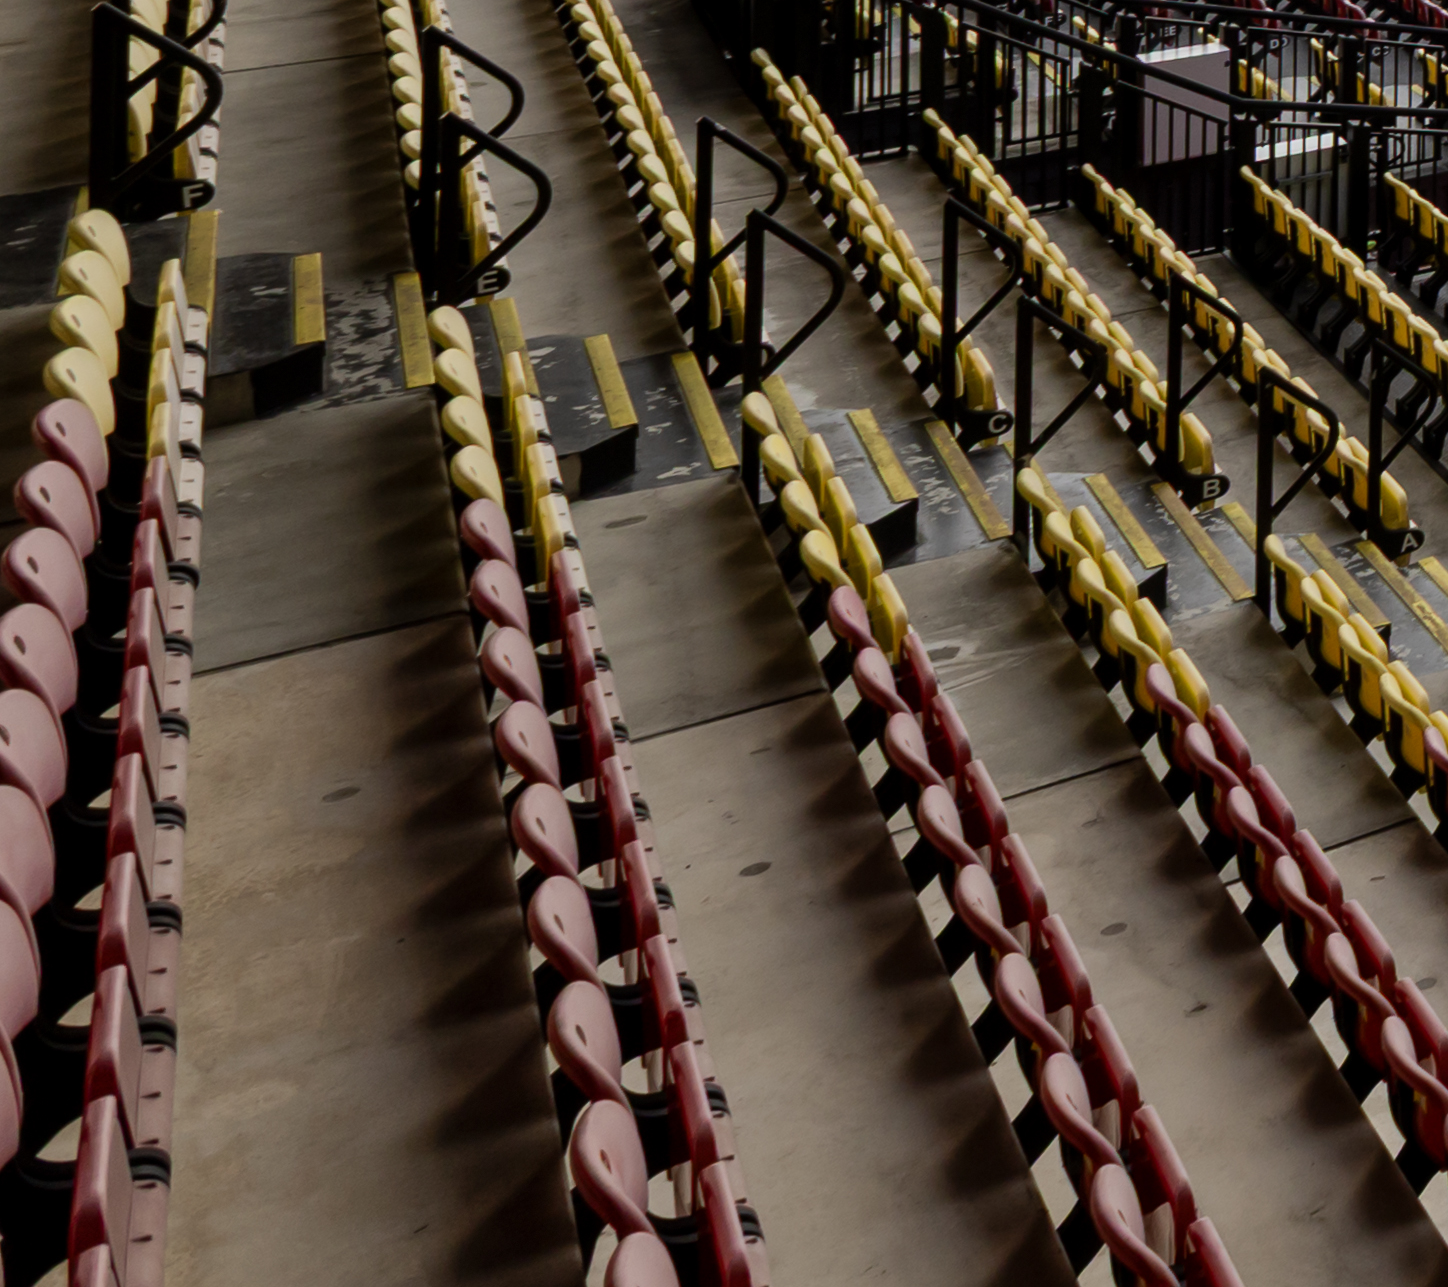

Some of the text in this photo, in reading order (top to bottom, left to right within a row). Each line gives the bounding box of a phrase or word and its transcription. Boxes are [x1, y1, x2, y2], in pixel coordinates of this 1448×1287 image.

[183, 182, 205, 209] F
[478, 269, 500, 295] E
[989, 414, 1008, 434] C
[1203, 478, 1221, 500] B
[1401, 532, 1419, 554] A
